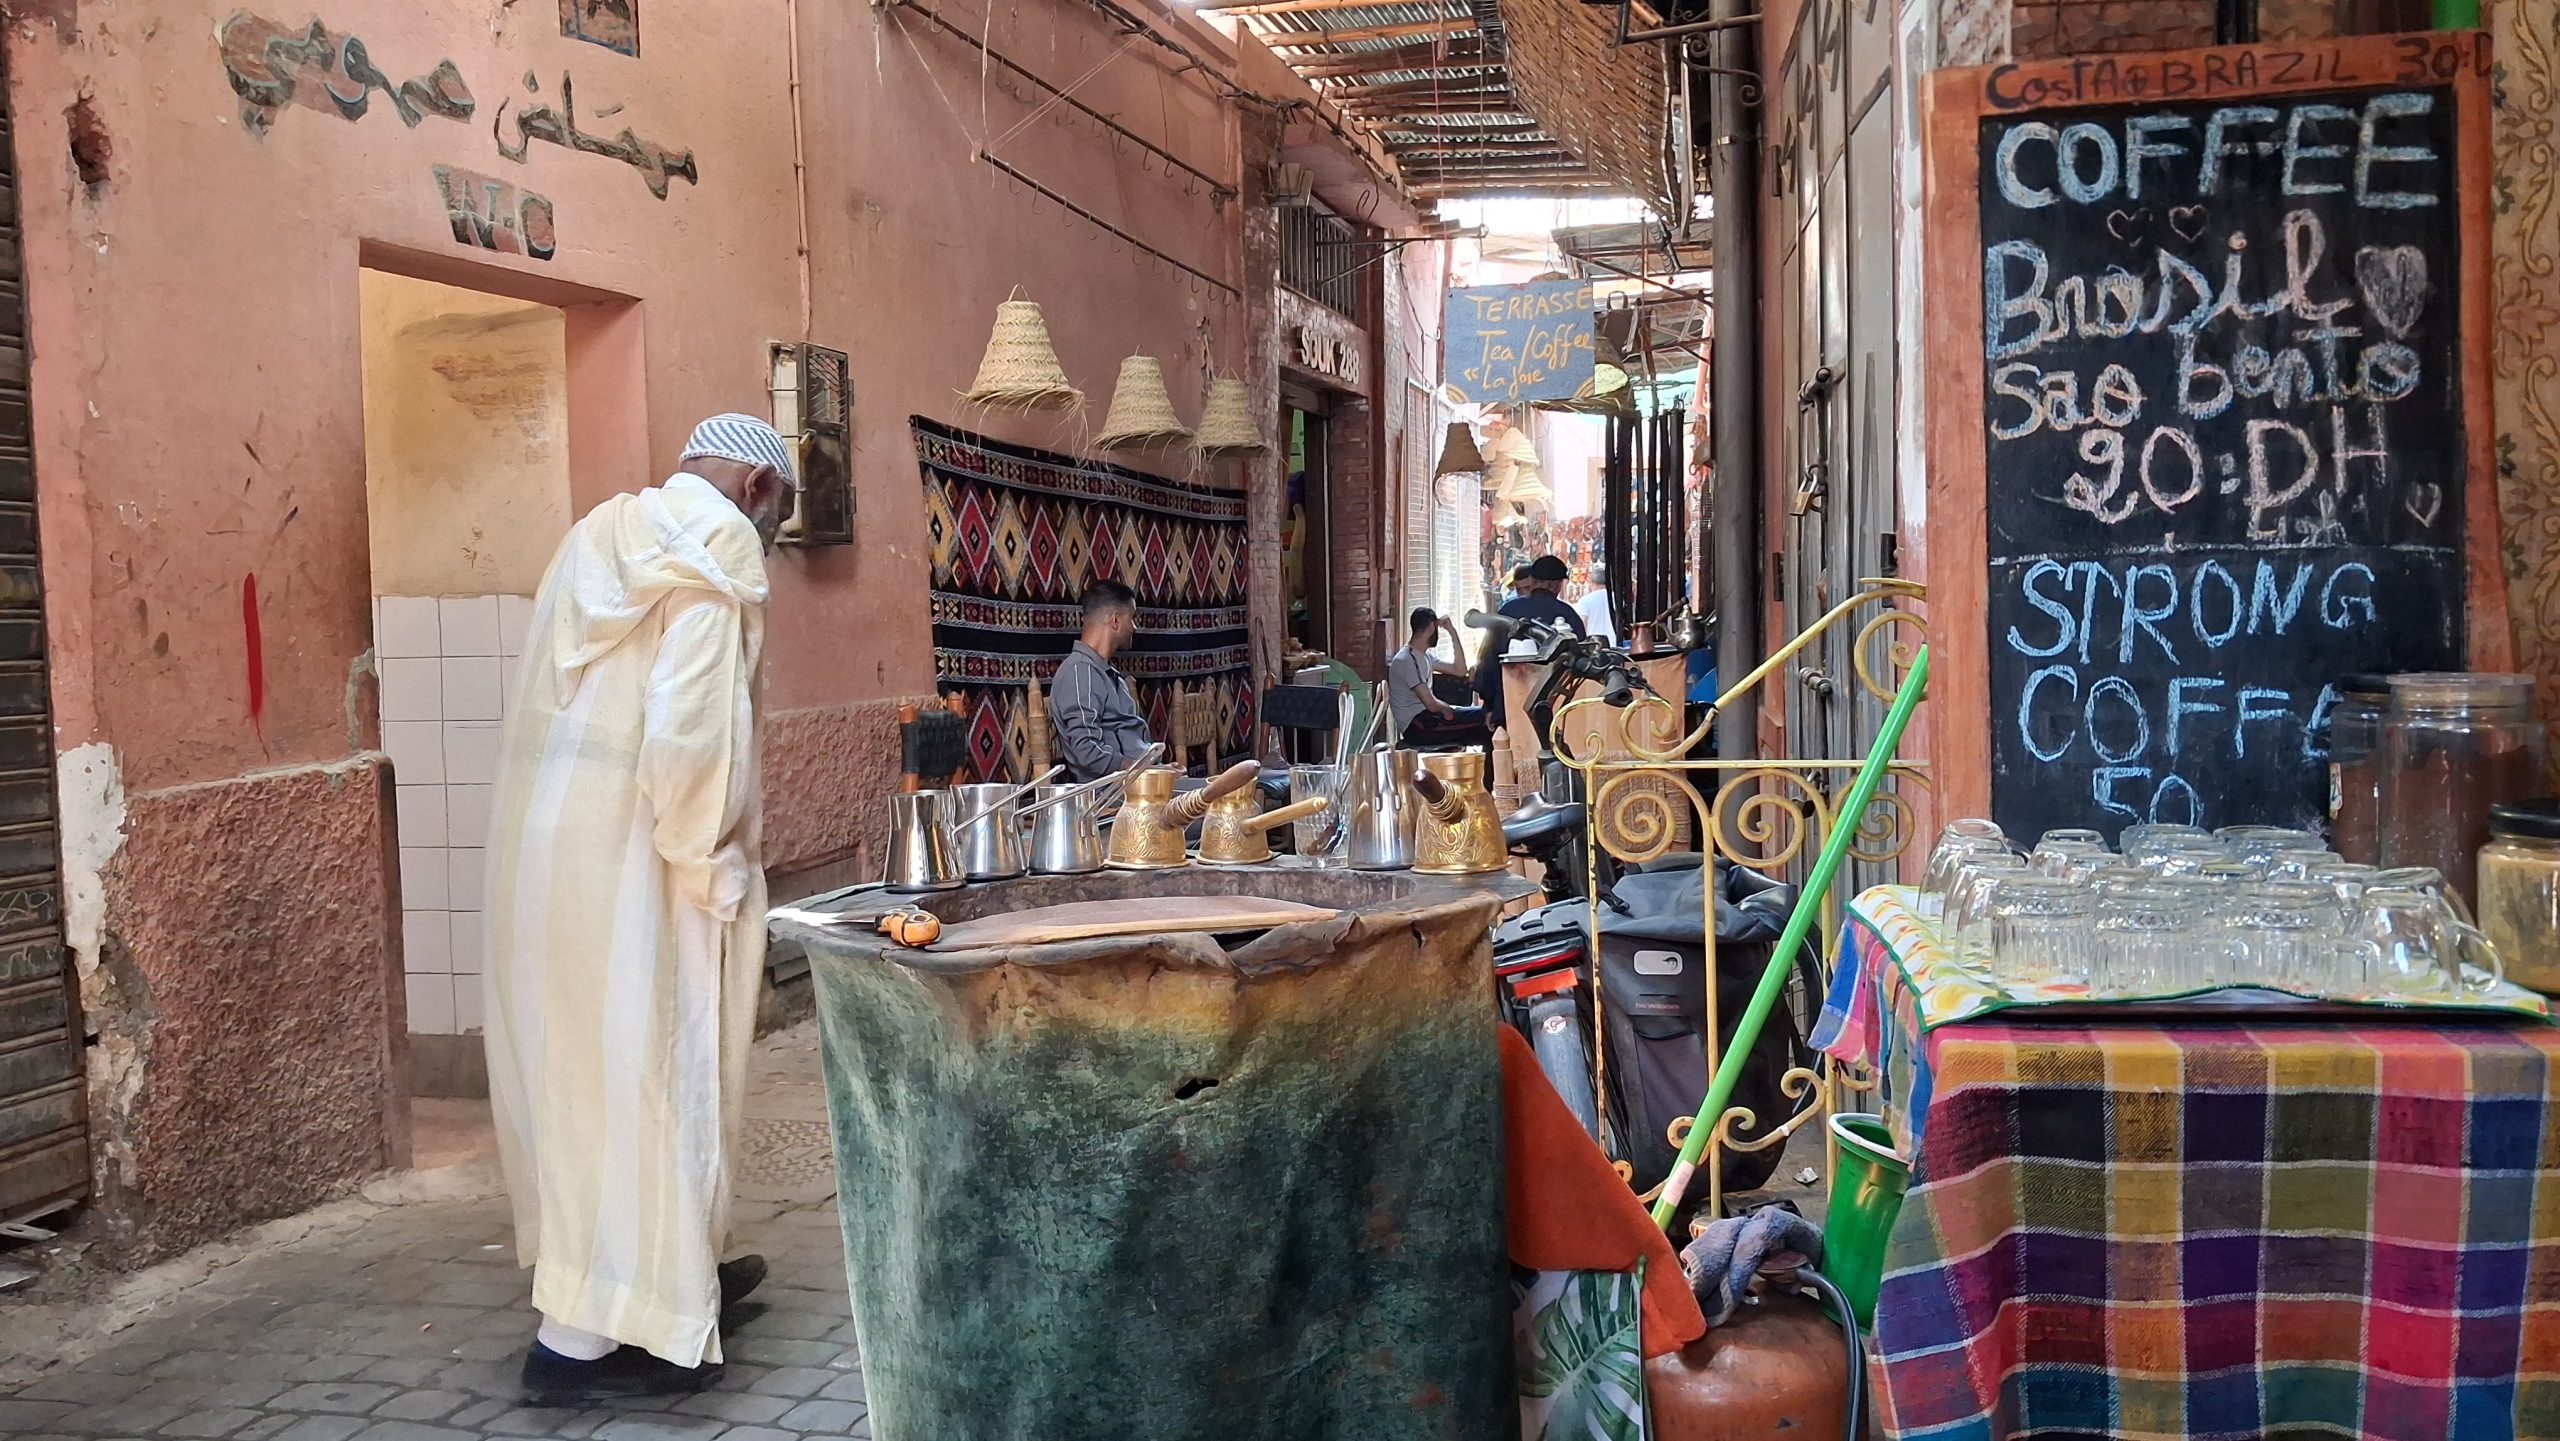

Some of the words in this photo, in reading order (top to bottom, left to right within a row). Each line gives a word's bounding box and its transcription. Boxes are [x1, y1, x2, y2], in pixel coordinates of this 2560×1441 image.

[1995, 93, 2439, 209] COFFEE
[1465, 287, 1593, 322] TERRASSE
[1301, 326, 1337, 376] SOUK
[1339, 342, 1360, 385] 288
[2006, 559, 2377, 667] STRONG
